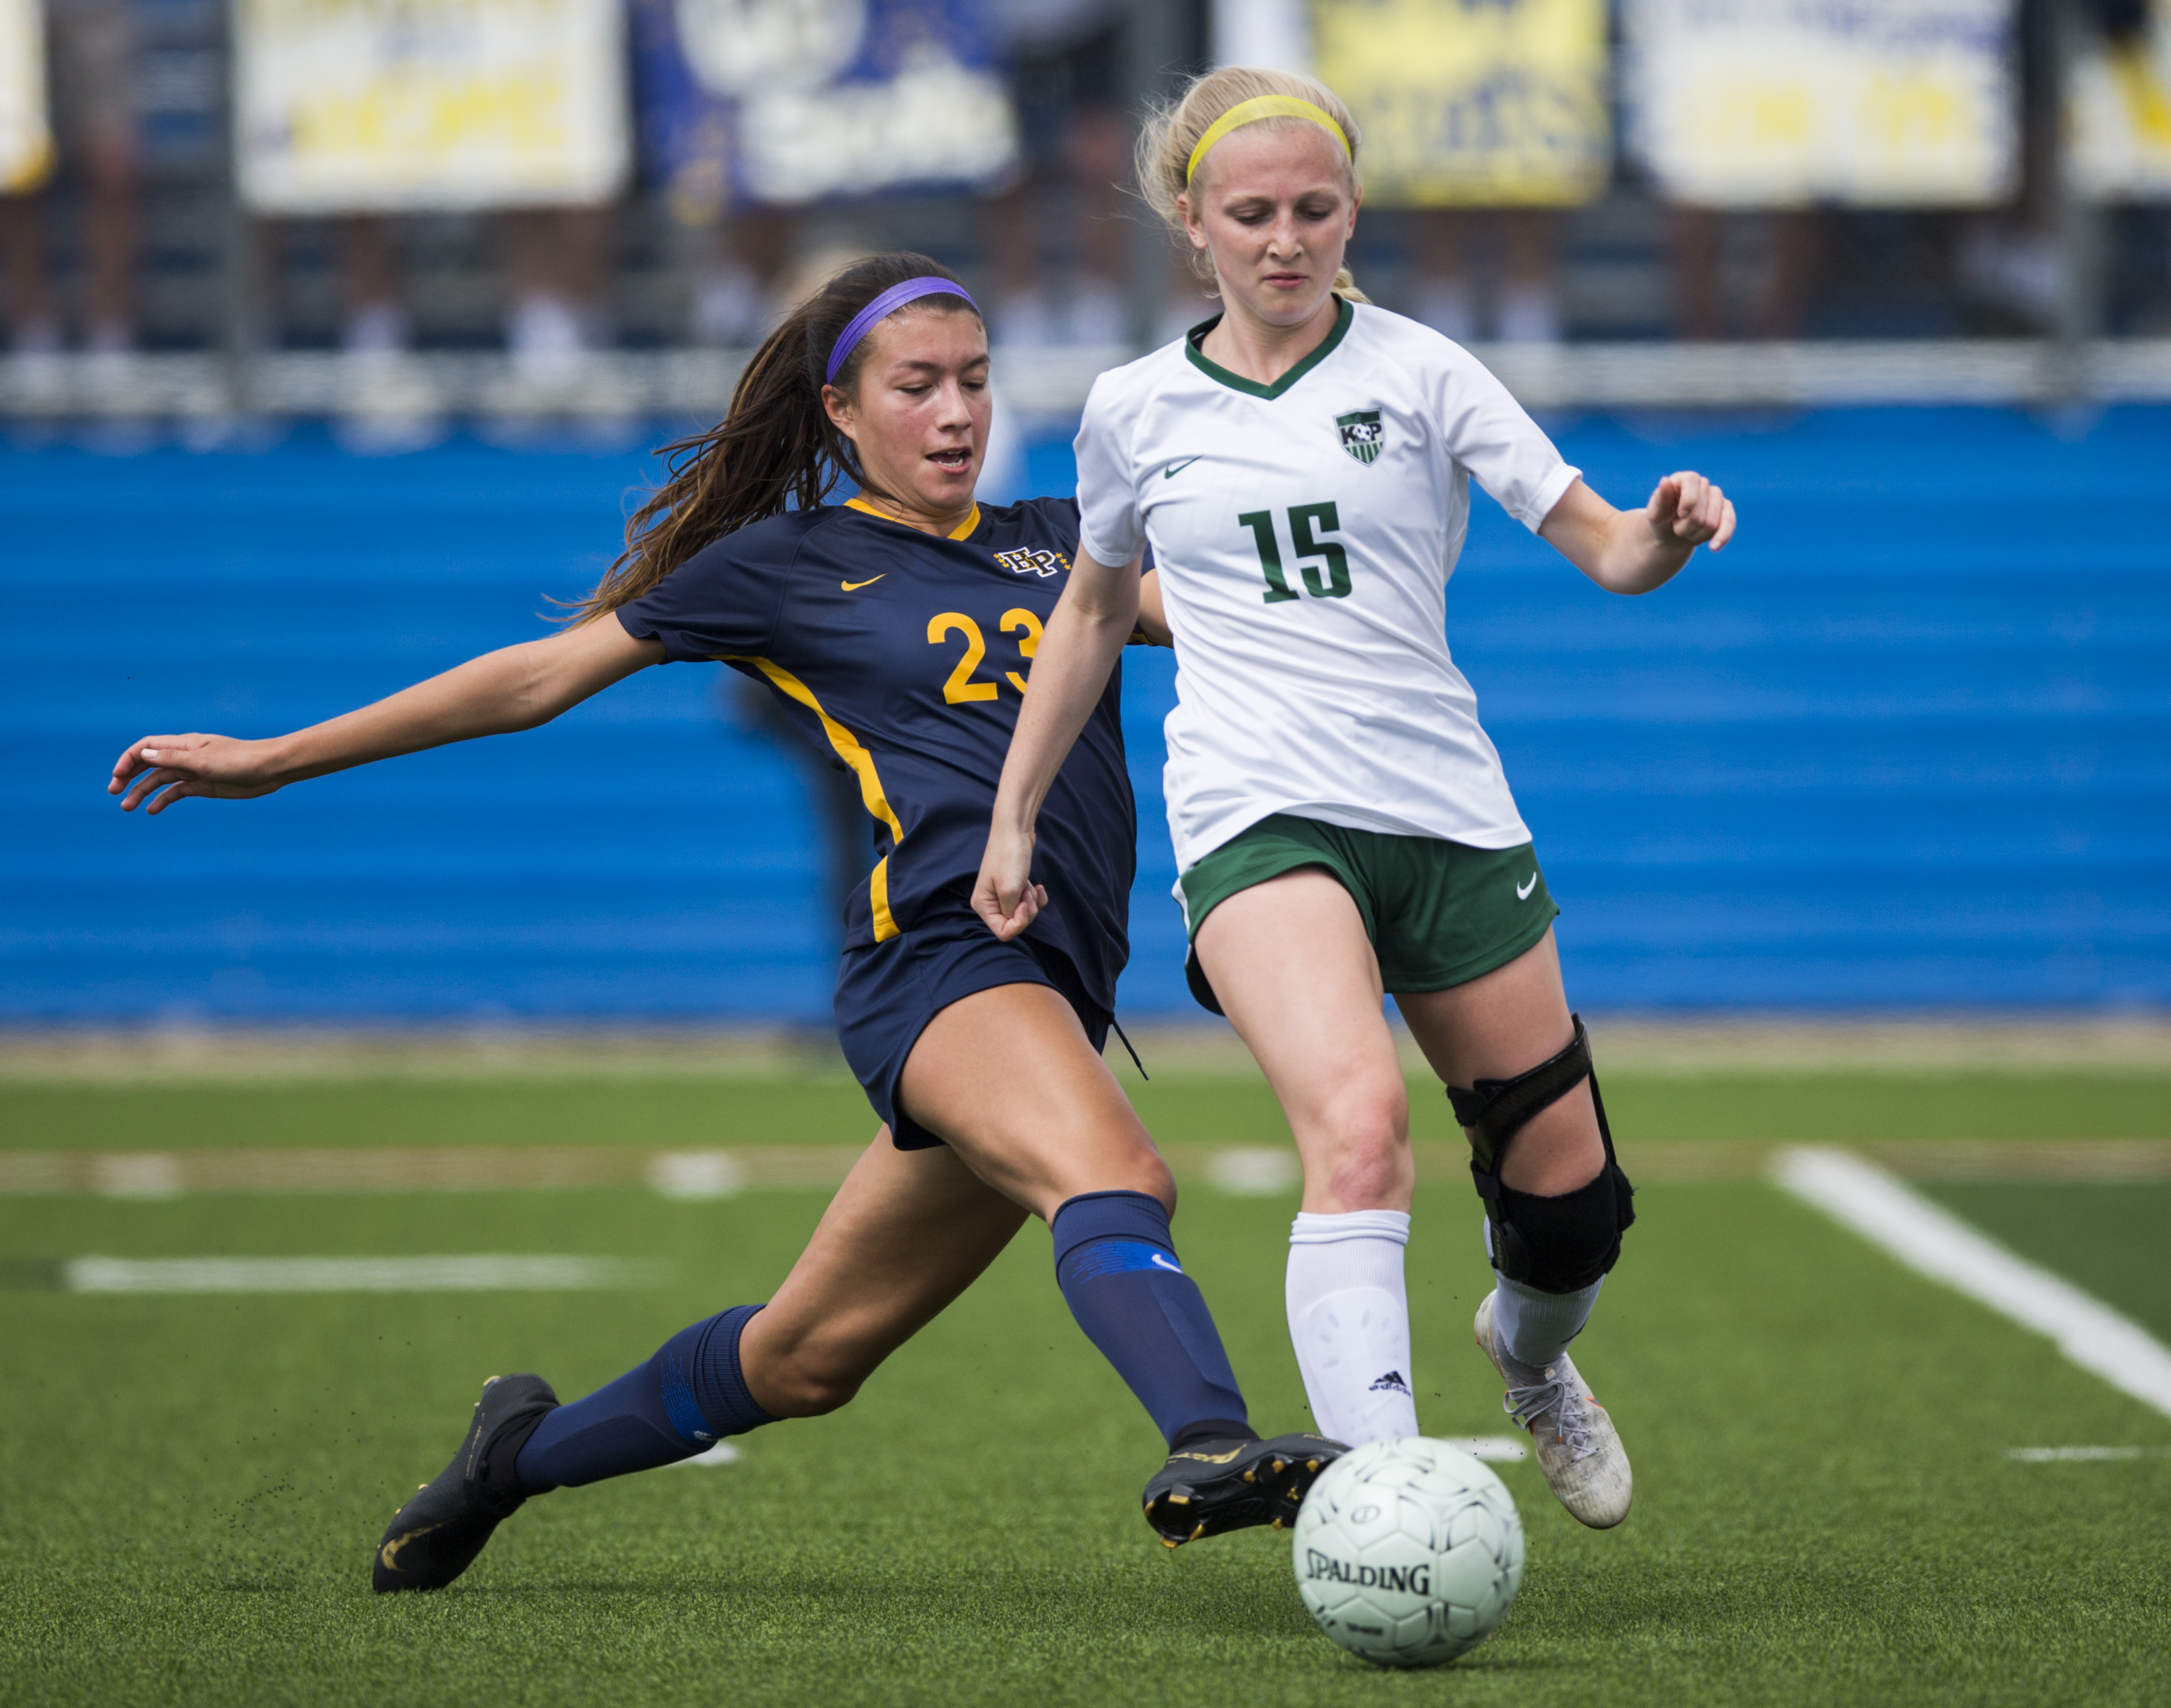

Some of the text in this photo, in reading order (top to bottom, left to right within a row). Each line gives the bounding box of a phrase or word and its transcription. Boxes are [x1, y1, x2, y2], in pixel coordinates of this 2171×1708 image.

[1238, 501, 1352, 604] 15
[927, 608, 1044, 705] 23
[1307, 1547, 1430, 1596] SPALDING
